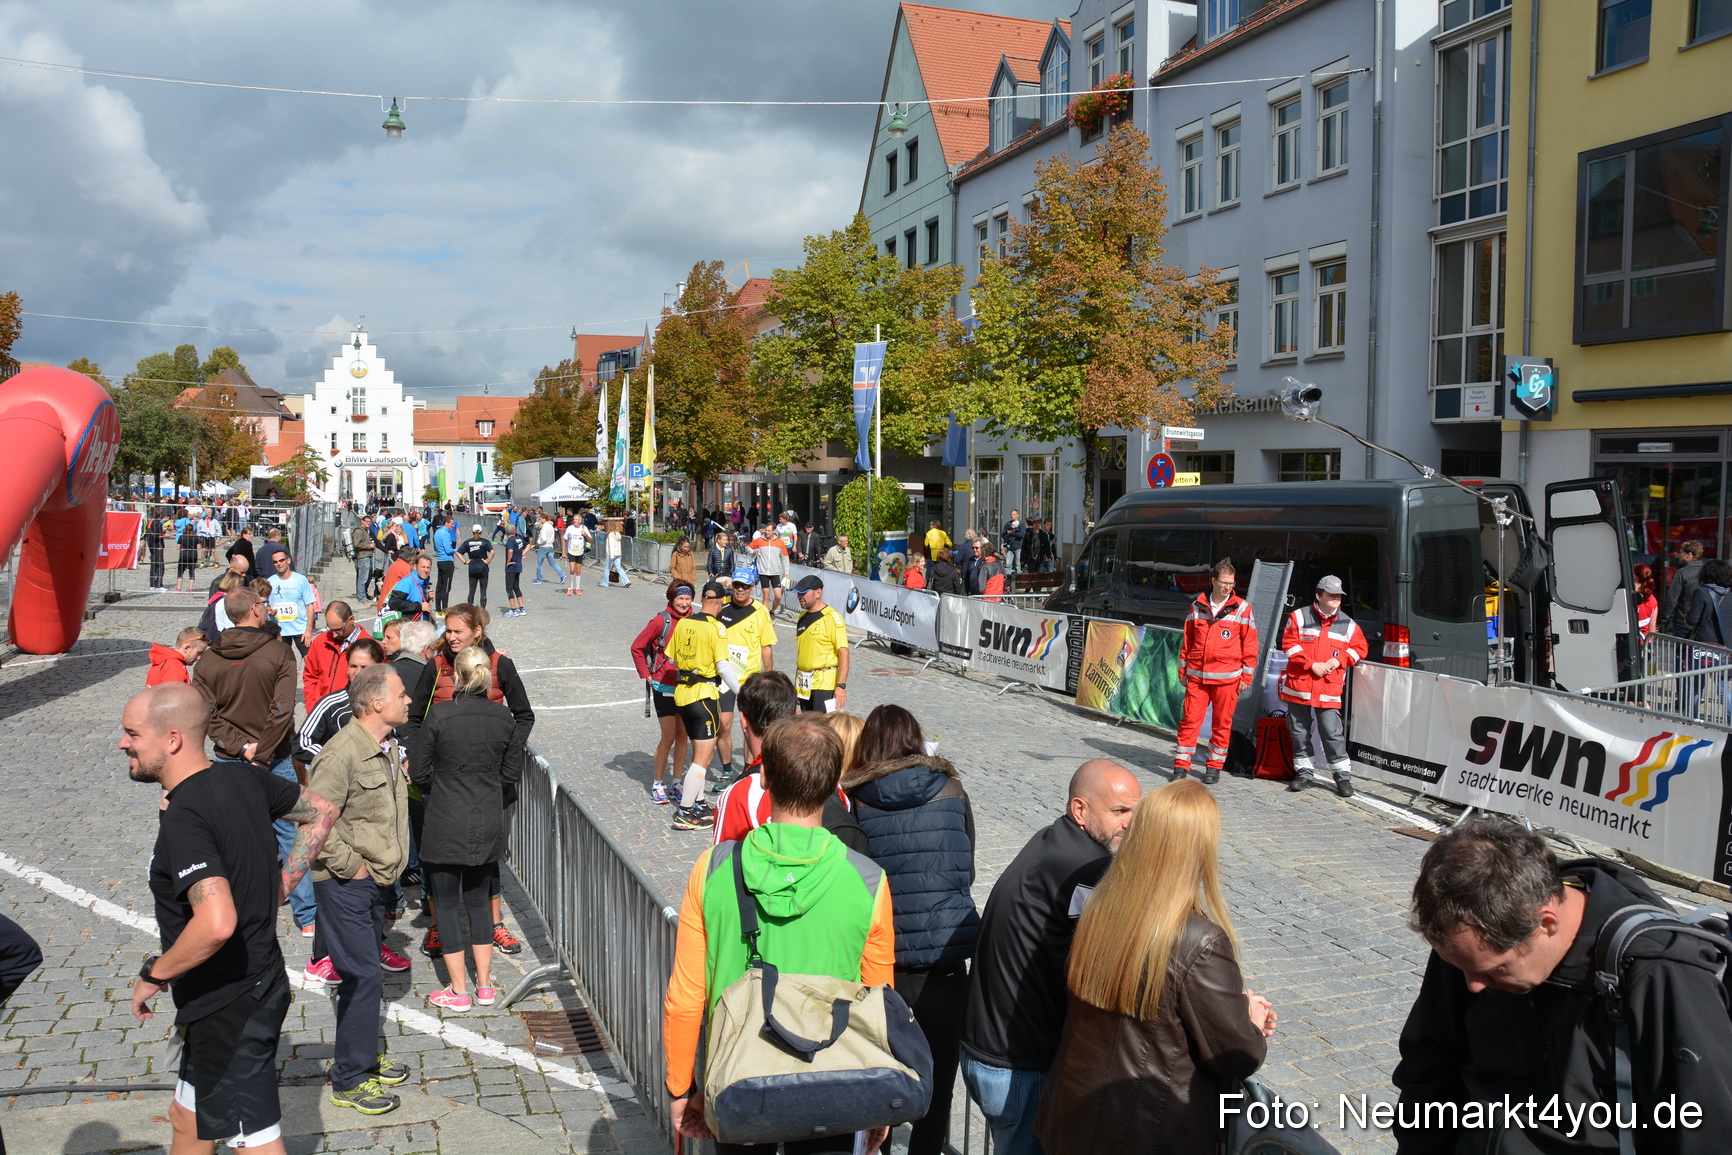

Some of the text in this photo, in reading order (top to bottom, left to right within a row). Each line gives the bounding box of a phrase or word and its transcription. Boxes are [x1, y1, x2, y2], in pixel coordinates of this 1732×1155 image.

[1528, 373, 1545, 399] G2
[1165, 427, 1204, 438] Brunnwirtsgasse
[369, 456, 408, 464] Laufsport
[633, 465, 641, 476] P
[1174, 476, 1194, 484] etten
[927, 503, 943, 512] Nide
[280, 606, 294, 615] 143
[860, 596, 915, 627] BMW Laufsport
[978, 619, 1033, 657] swn
[978, 650, 1046, 676] stadtwerke neumarkt
[1357, 749, 1437, 778] Leistungen, die verbinden
[1465, 716, 1607, 797] swn
[1458, 769, 1652, 840] stadtwerke neumarkt
[178, 861, 208, 879] Markus
